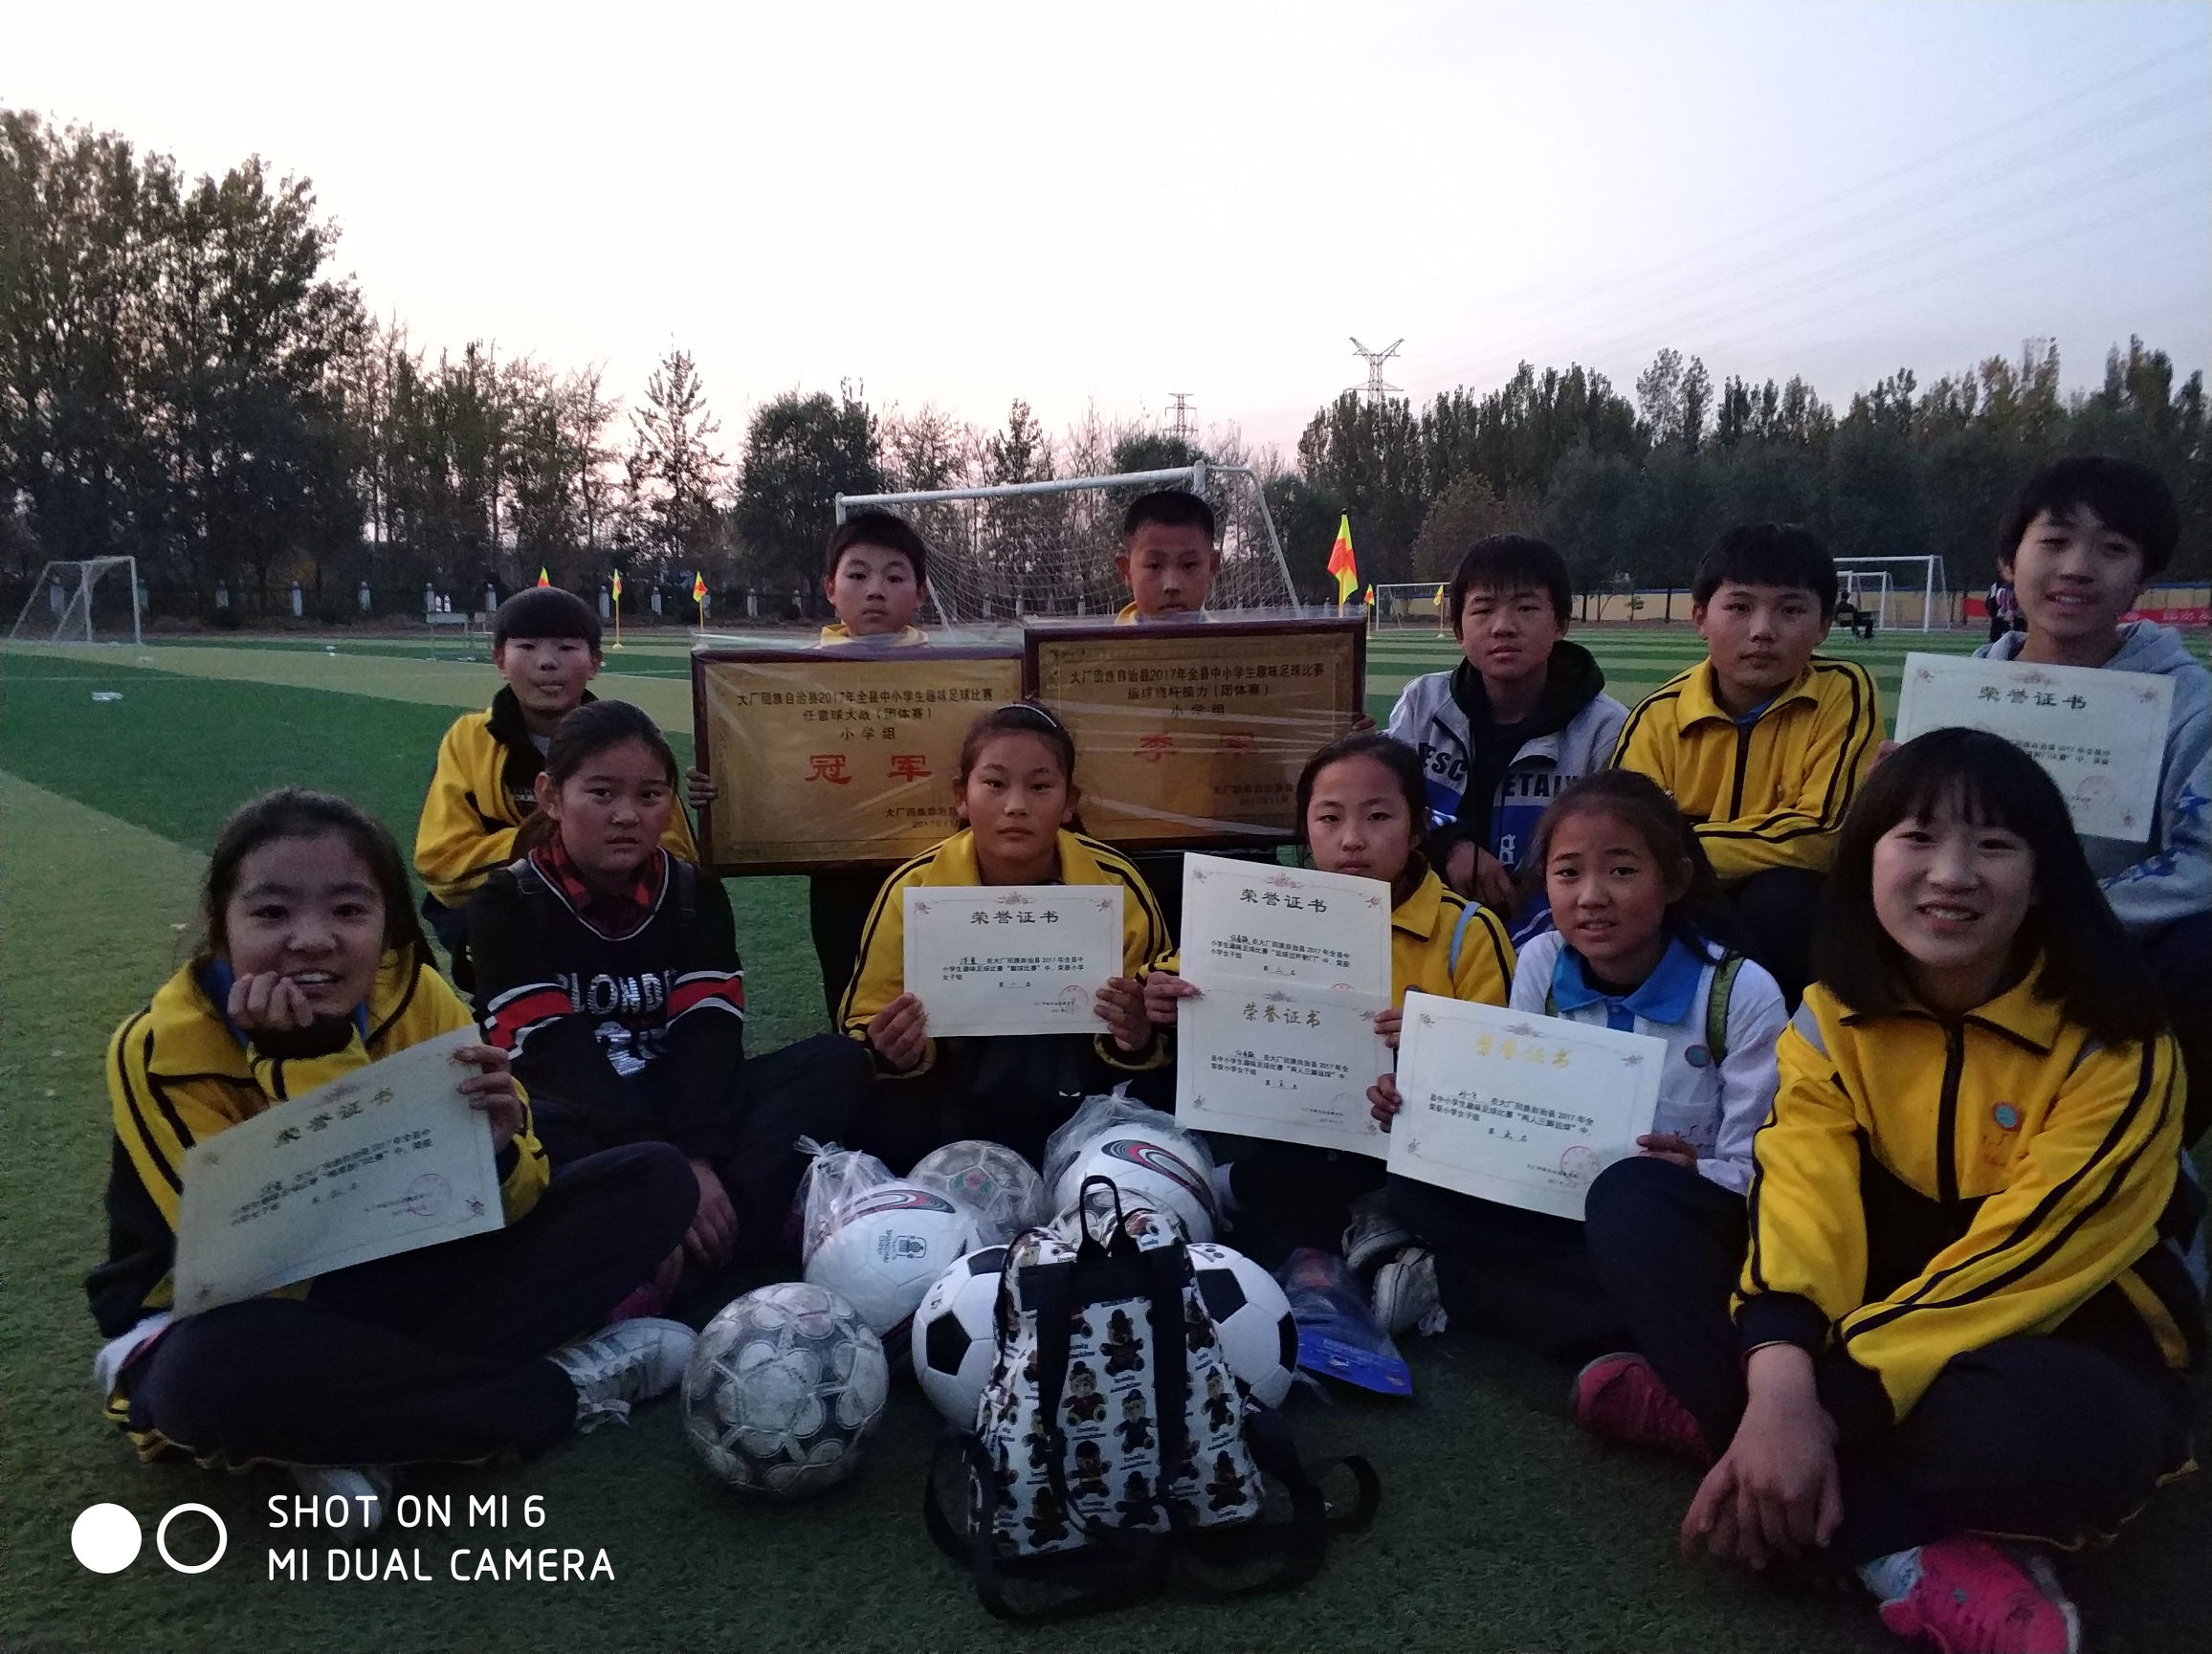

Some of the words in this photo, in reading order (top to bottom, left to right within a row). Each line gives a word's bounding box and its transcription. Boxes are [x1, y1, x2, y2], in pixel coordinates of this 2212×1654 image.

[1978, 686, 2087, 710] 荣誉证书
[841, 727, 896, 740] 小学组
[805, 754, 932, 784] 冠军
[1240, 888, 1327, 913] 荣誉证书
[969, 910, 1059, 924] 荣誉证书
[1243, 1003, 1321, 1028] 荣誉证书
